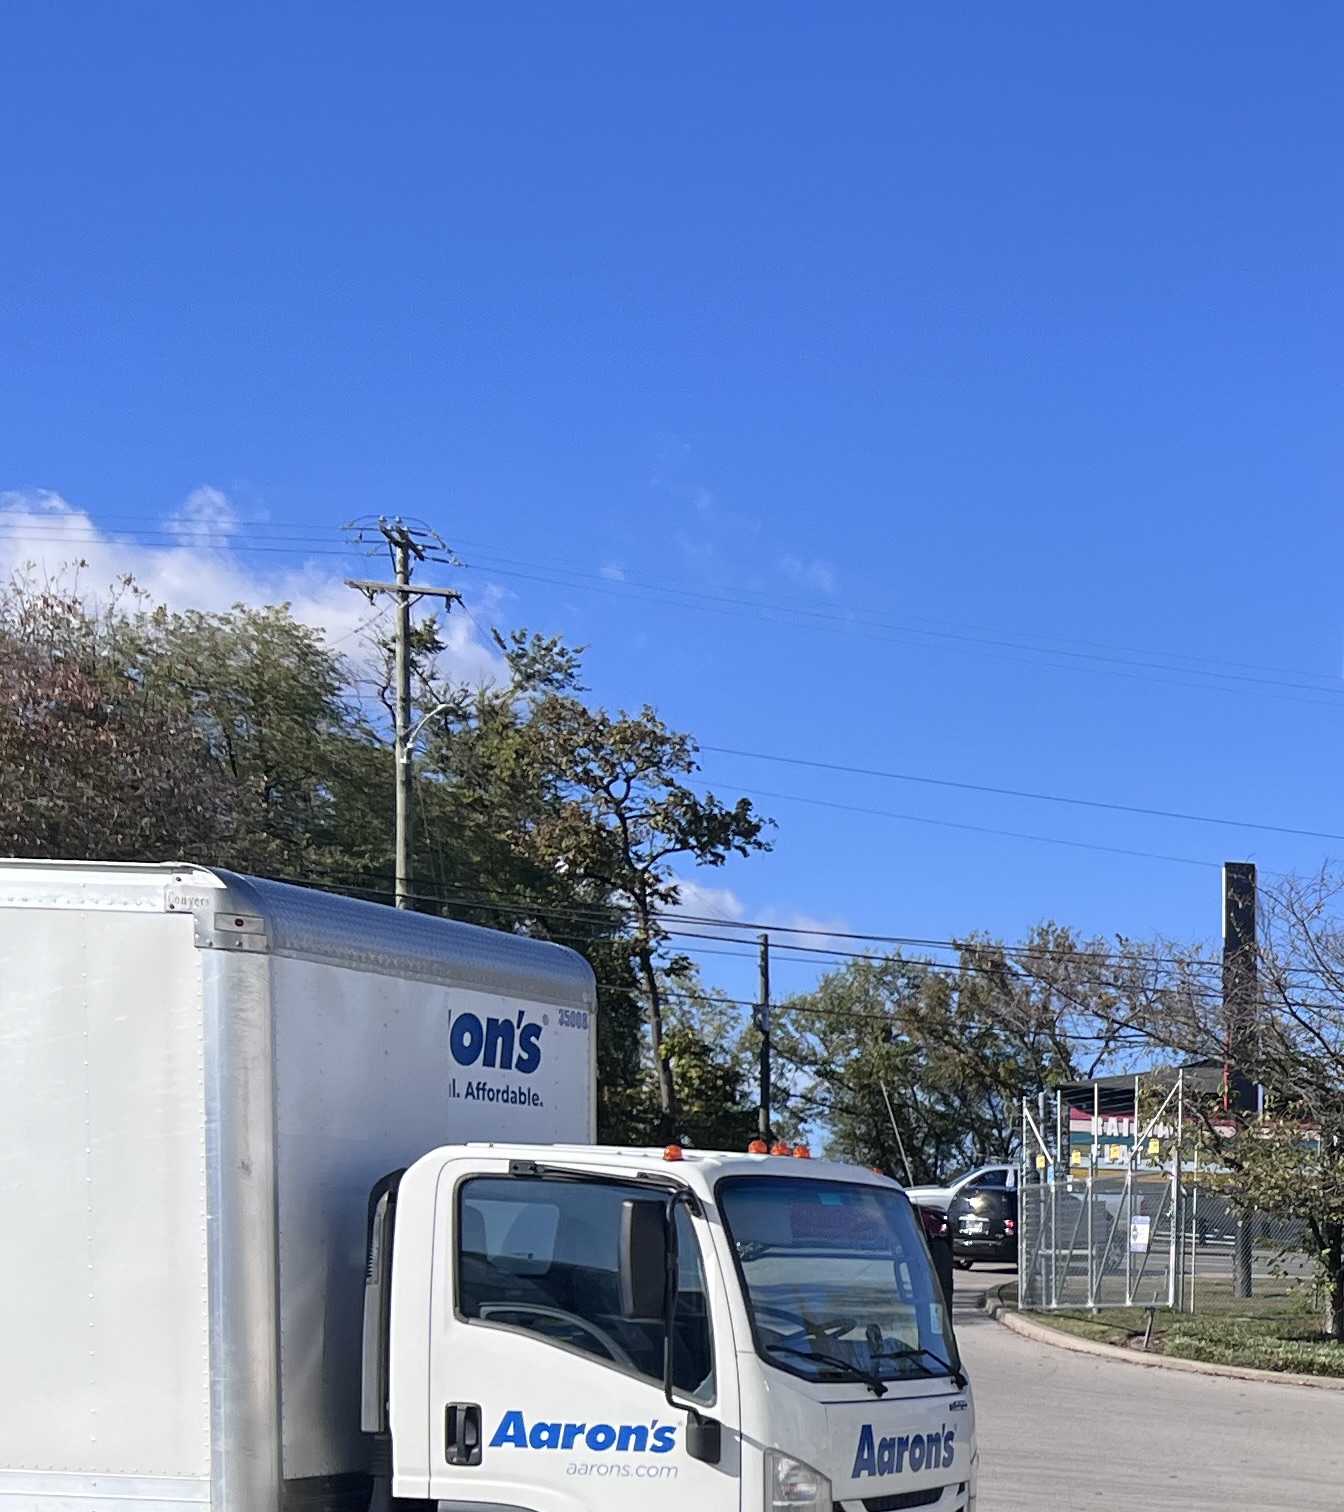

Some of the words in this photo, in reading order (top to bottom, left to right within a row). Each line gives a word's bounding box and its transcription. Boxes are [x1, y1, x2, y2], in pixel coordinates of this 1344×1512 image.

[448, 1009, 543, 1074] on's
[464, 1081, 544, 1108] Affordable.
[489, 1410, 677, 1454] Aaron's
[851, 1423, 955, 1479] Aaron's
[566, 1462, 679, 1479] aarons.com
